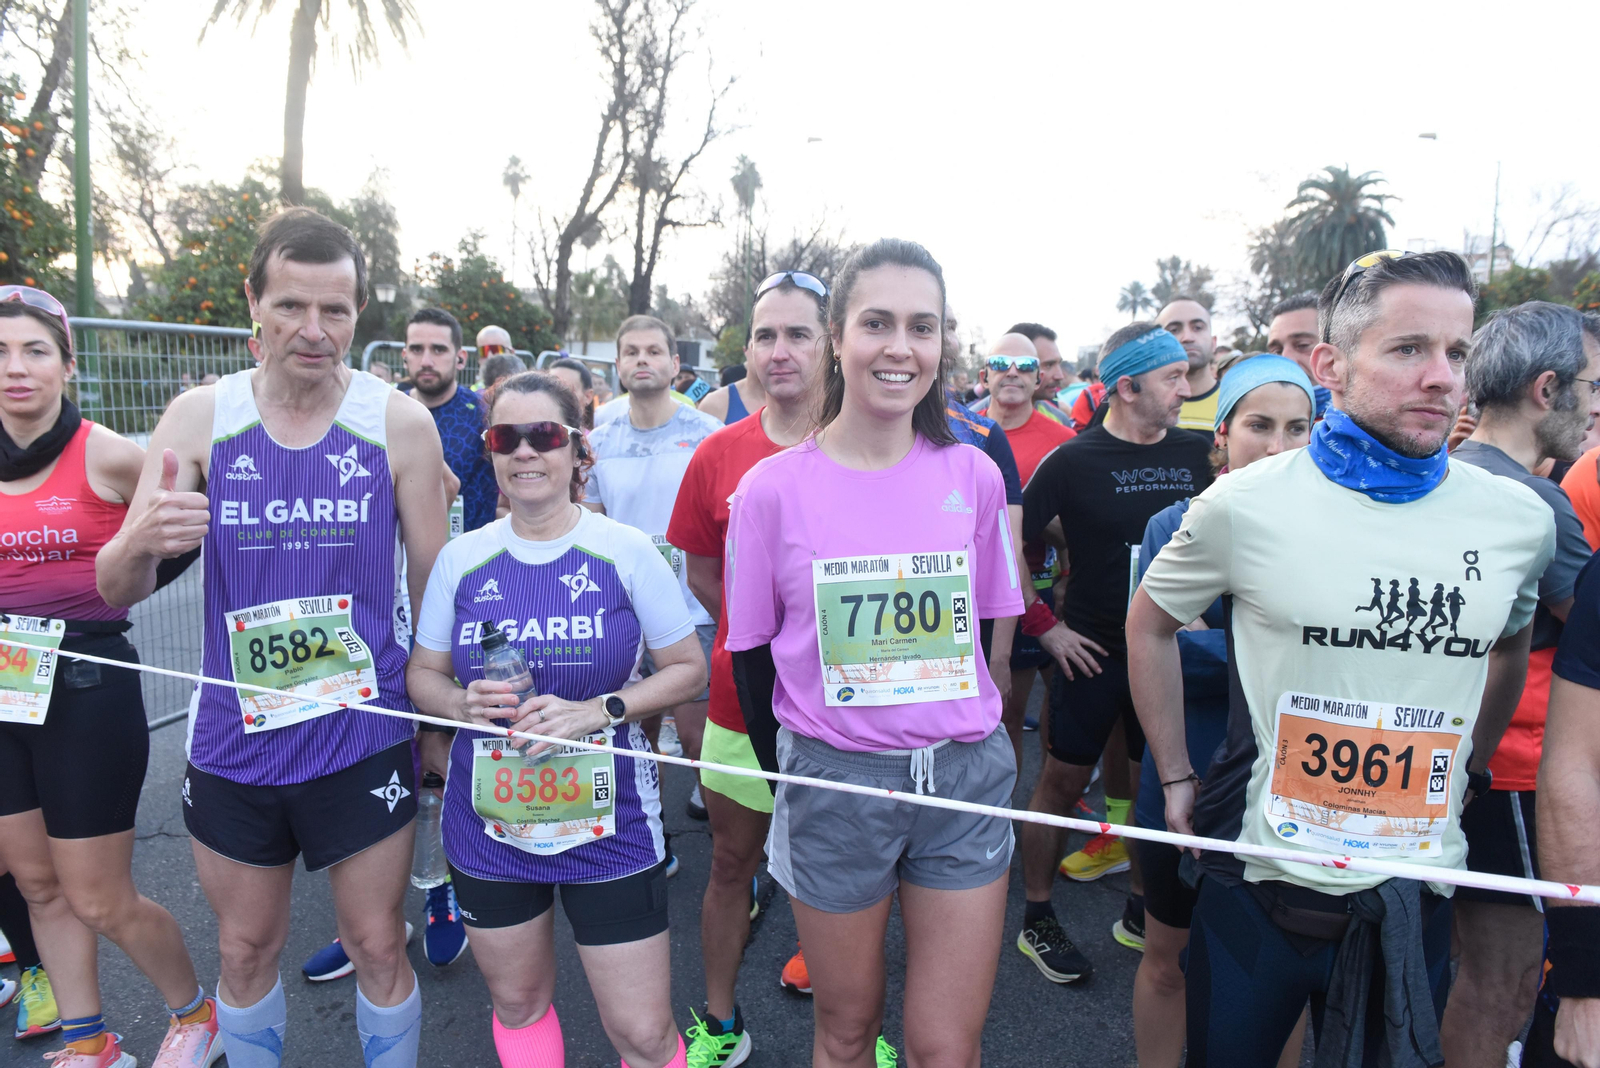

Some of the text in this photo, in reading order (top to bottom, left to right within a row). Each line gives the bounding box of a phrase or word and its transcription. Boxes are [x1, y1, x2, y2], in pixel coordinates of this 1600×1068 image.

[1111, 467, 1193, 485] WONG
[1115, 483, 1195, 494] PERFORMANCE
[220, 492, 373, 525] EL GARBÍ
[941, 504, 973, 514] adids
[237, 530, 273, 540] CLUB
[279, 529, 294, 538] DE
[282, 541, 311, 551] 1995
[823, 554, 952, 576] MEDIO MARATÓN SEVILLA
[232, 598, 334, 624] MEDIO MARATÓN SEVILLA
[840, 590, 941, 638] 7780
[495, 608, 606, 642] GARBÍ
[249, 626, 335, 673] 8582
[871, 637, 918, 646] Mari Carmen
[1302, 625, 1493, 658] RUN4YOU
[0, 642, 29, 673] 84
[528, 660, 544, 669] 95
[284, 665, 304, 676] Pablo
[893, 686, 915, 695] HOKA
[298, 702, 320, 714] HOKA
[1290, 694, 1445, 728] MEDIO MARATÓN SEVILLA
[482, 740, 504, 752] MEDIO
[1279, 745, 1289, 766] CAJÓN
[1301, 733, 1415, 789] 3961
[493, 766, 582, 804] 8583
[1337, 786, 1377, 798] JONNHY
[1322, 800, 1362, 814] Colominas
[1342, 838, 1370, 850] HOKA
